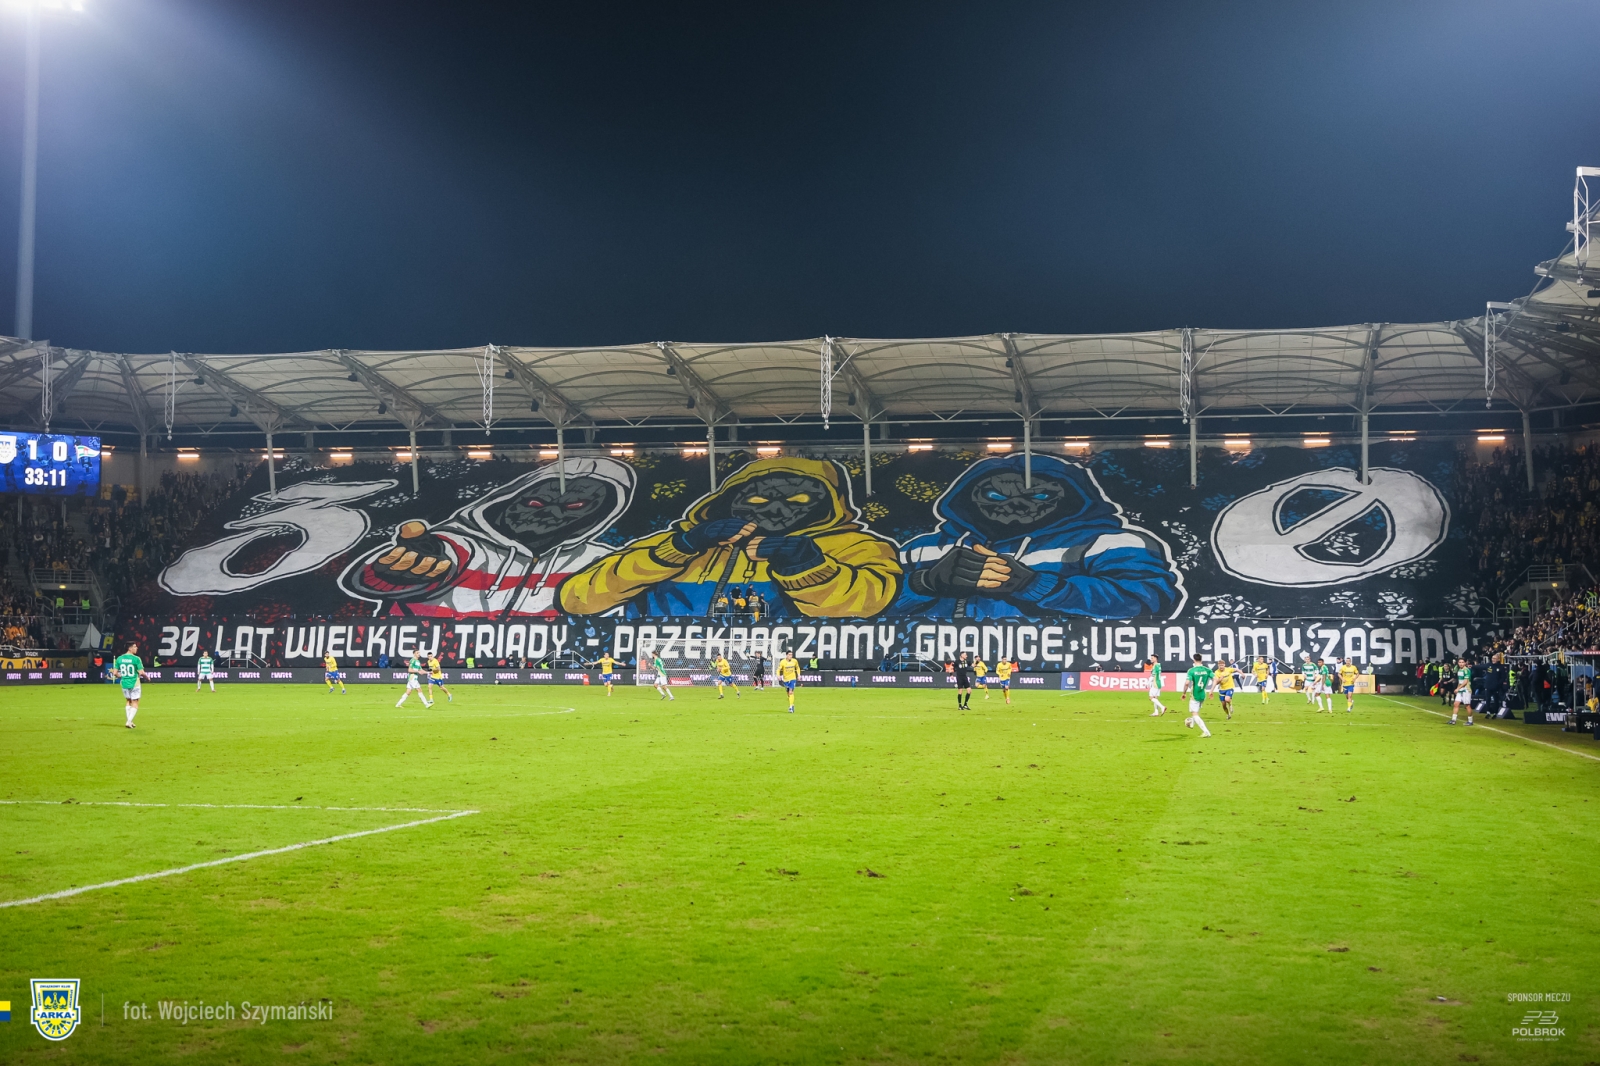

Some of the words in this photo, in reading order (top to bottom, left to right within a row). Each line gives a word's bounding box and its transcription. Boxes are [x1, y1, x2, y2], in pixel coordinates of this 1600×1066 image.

[28, 440, 37, 460] 1
[53, 442, 68, 461] 0
[25, 468, 66, 486] 33:11
[158, 626, 200, 657] 30
[215, 625, 275, 659] LAT
[285, 625, 441, 659] WIELKIEJ
[454, 625, 568, 659] TRIADY
[613, 625, 896, 660] PRZEKRACZAMY
[1091, 626, 1301, 663] USTALAMY
[1317, 627, 1467, 665] ZASADY
[120, 663, 135, 677] 80
[1089, 675, 1166, 689] SUPERBT
[1197, 676, 1204, 690] 4
